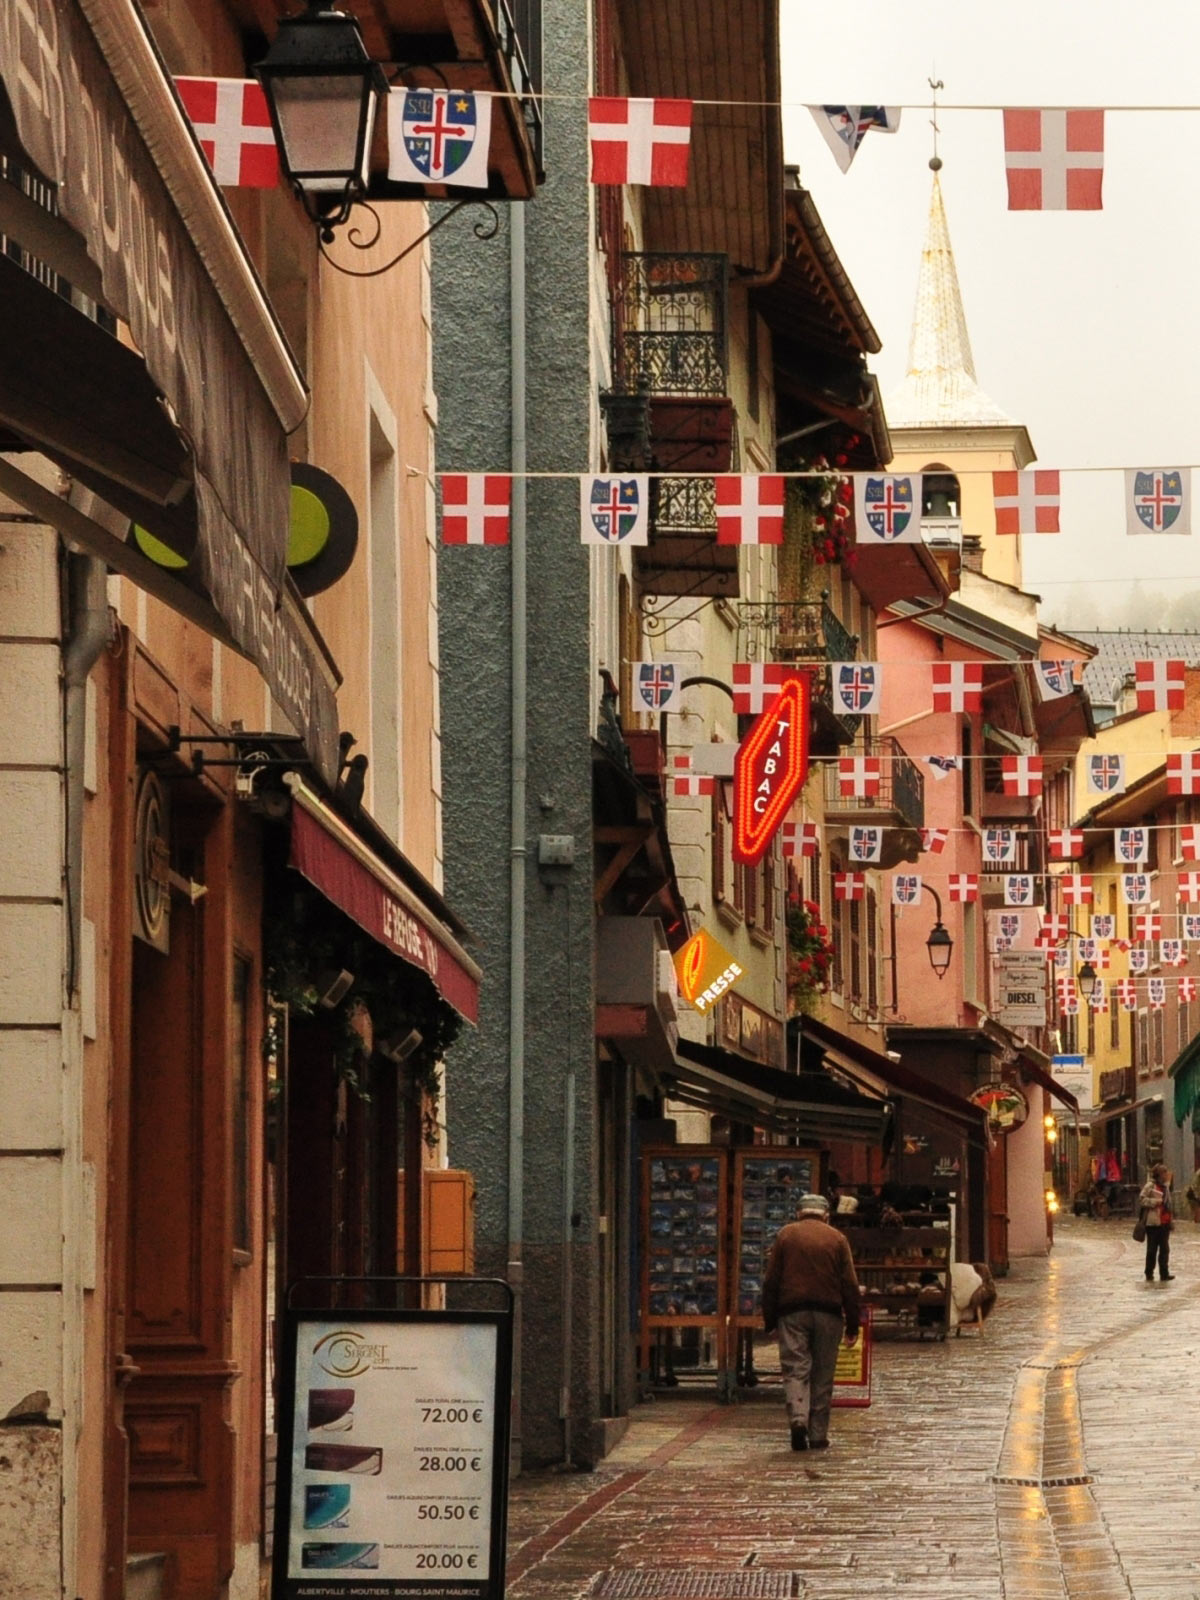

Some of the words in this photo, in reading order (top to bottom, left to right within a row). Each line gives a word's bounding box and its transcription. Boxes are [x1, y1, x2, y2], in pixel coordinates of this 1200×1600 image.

[752, 720, 790, 813] TABAC
[695, 962, 743, 1010] PRESSE
[1007, 993, 1036, 1004] DIESEL
[421, 1408, 468, 1423] 72.00
[473, 1409, 483, 1423] €
[419, 1456, 466, 1472] 28.00
[471, 1457, 481, 1472] €
[417, 1504, 465, 1520] 50.50
[469, 1505, 479, 1520] €
[415, 1553, 463, 1569] 20.00
[467, 1554, 478, 1569] €
[297, 1587, 345, 1597] ALBERTVILLE
[350, 1587, 389, 1597] MOUTIERS
[394, 1587, 422, 1597] BOURG
[423, 1587, 445, 1597] SAINT
[446, 1587, 480, 1597] MAURICE
